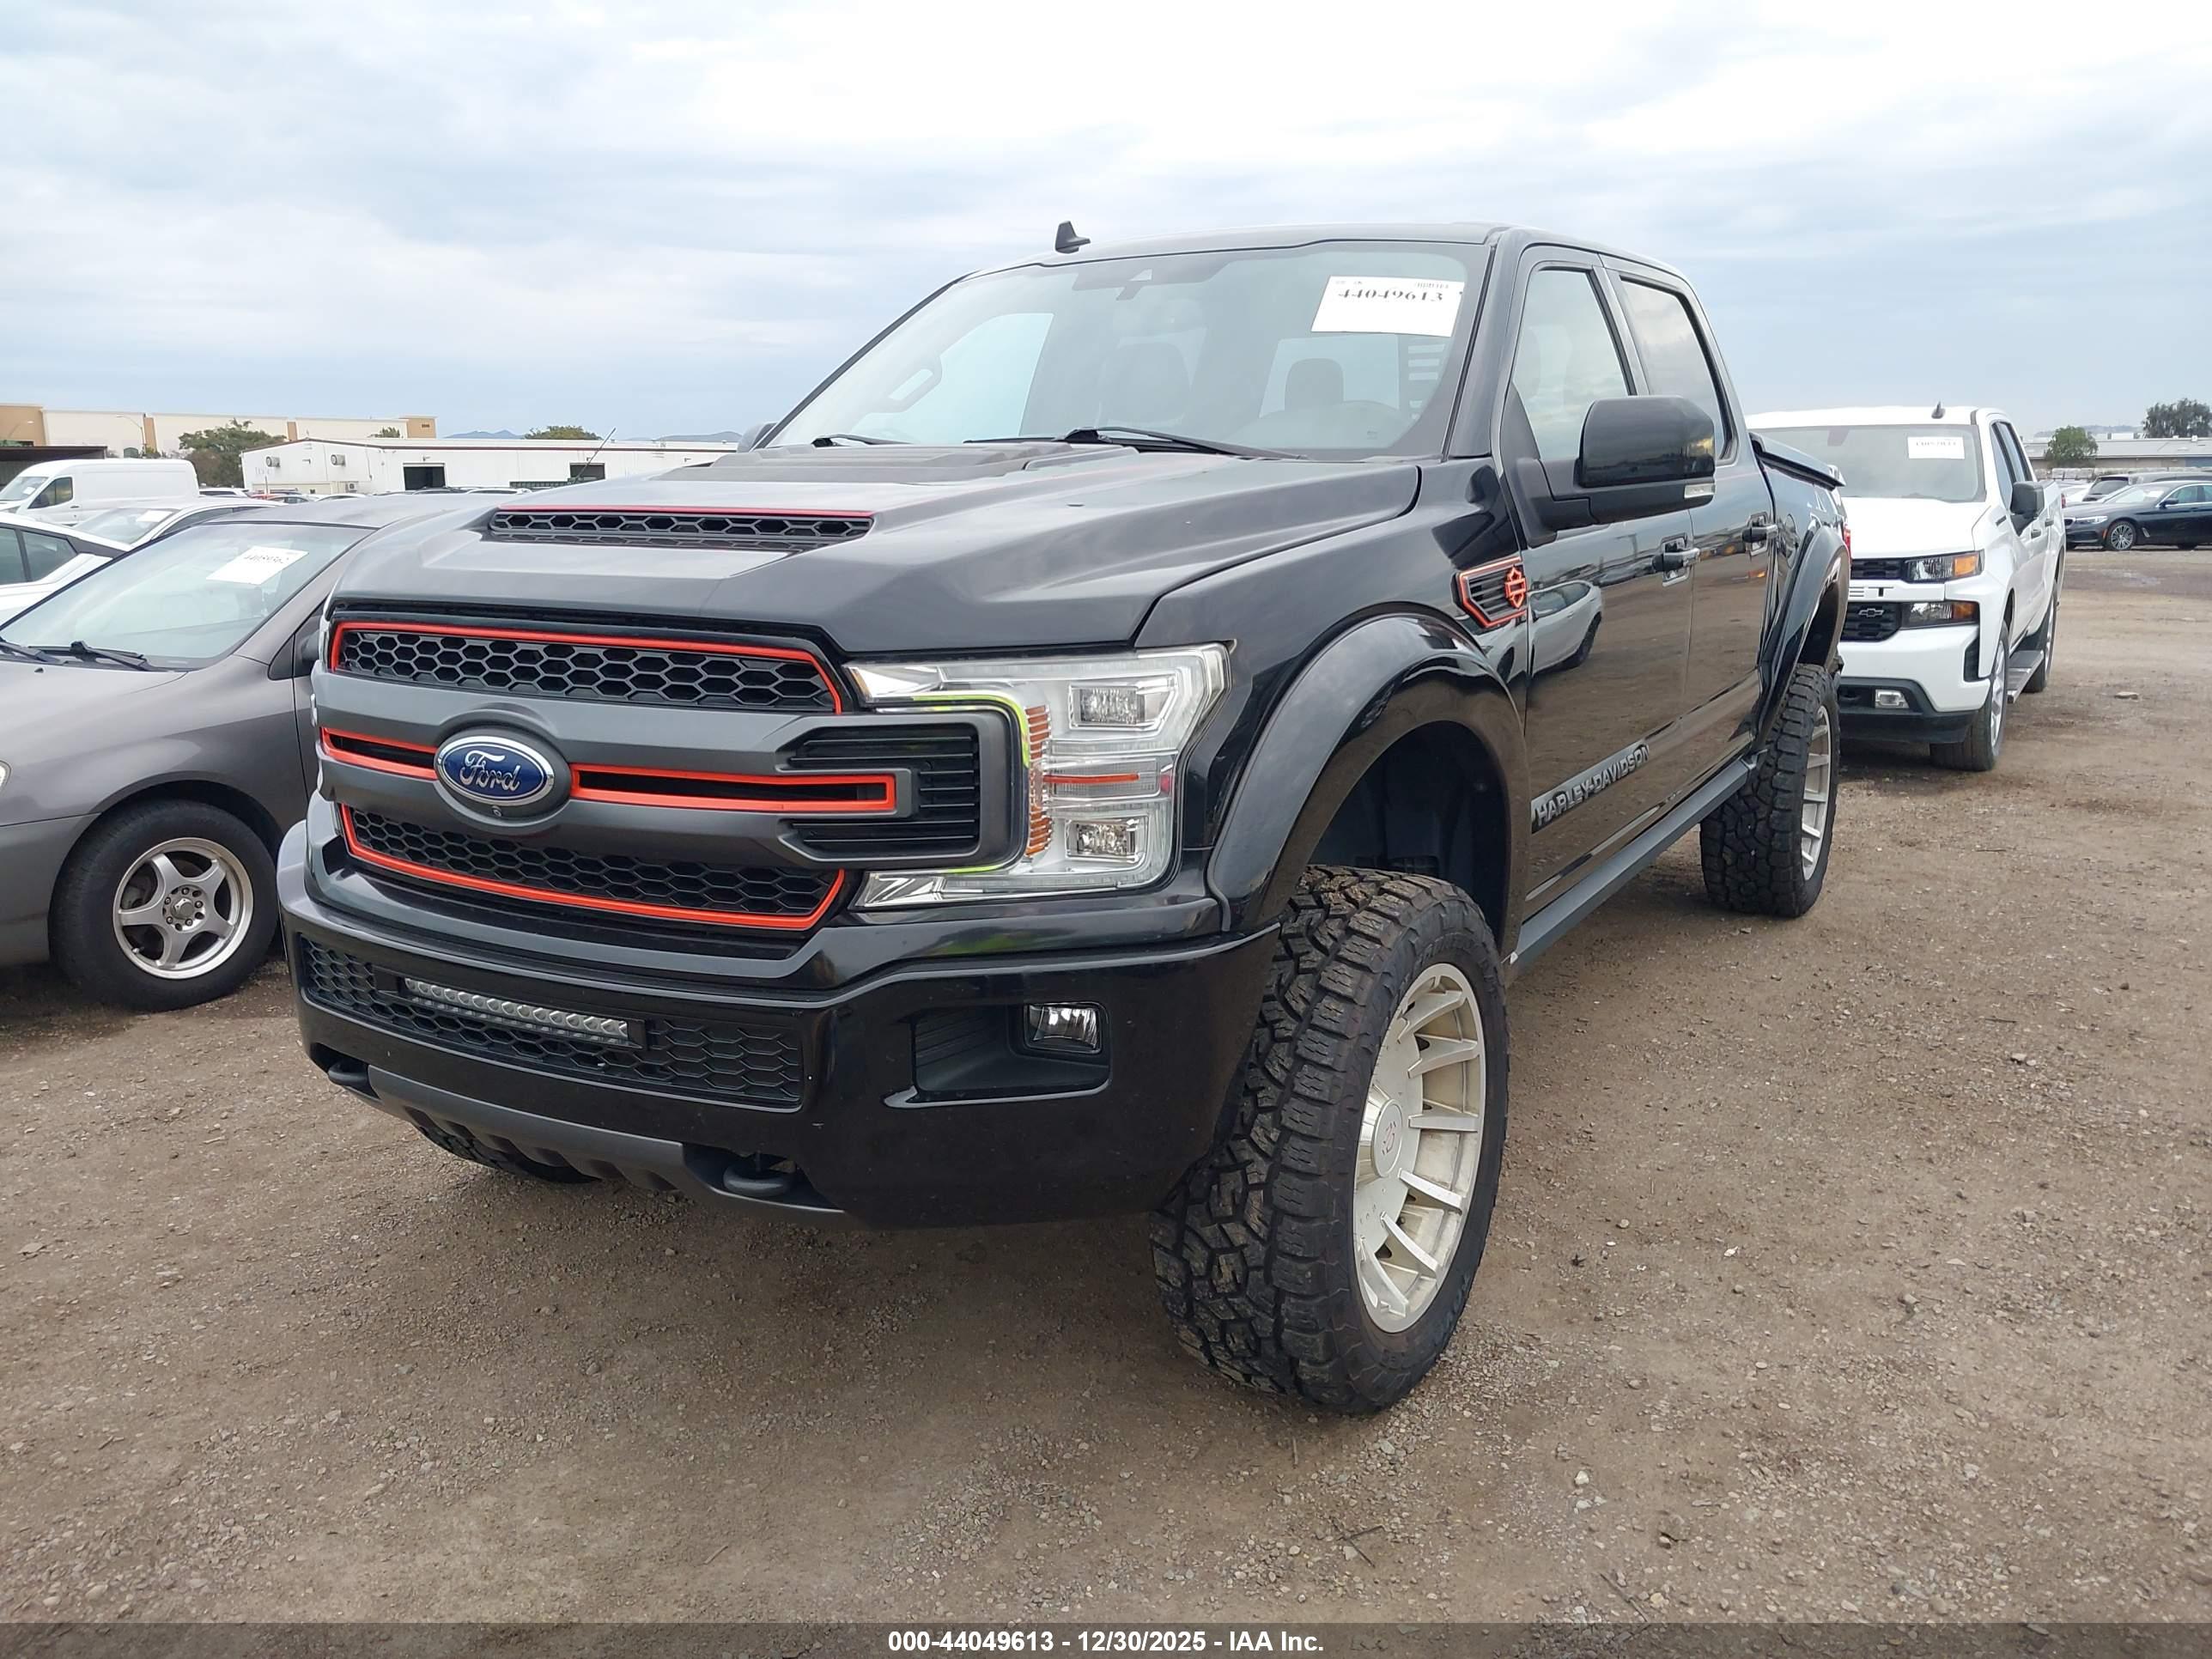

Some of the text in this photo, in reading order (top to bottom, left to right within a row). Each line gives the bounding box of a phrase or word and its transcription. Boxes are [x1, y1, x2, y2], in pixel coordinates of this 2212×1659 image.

[1337, 288, 1443, 302] 44049613
[459, 750, 521, 792] Ford
[1535, 744, 1650, 826] HARLEY-DAVIDSON
